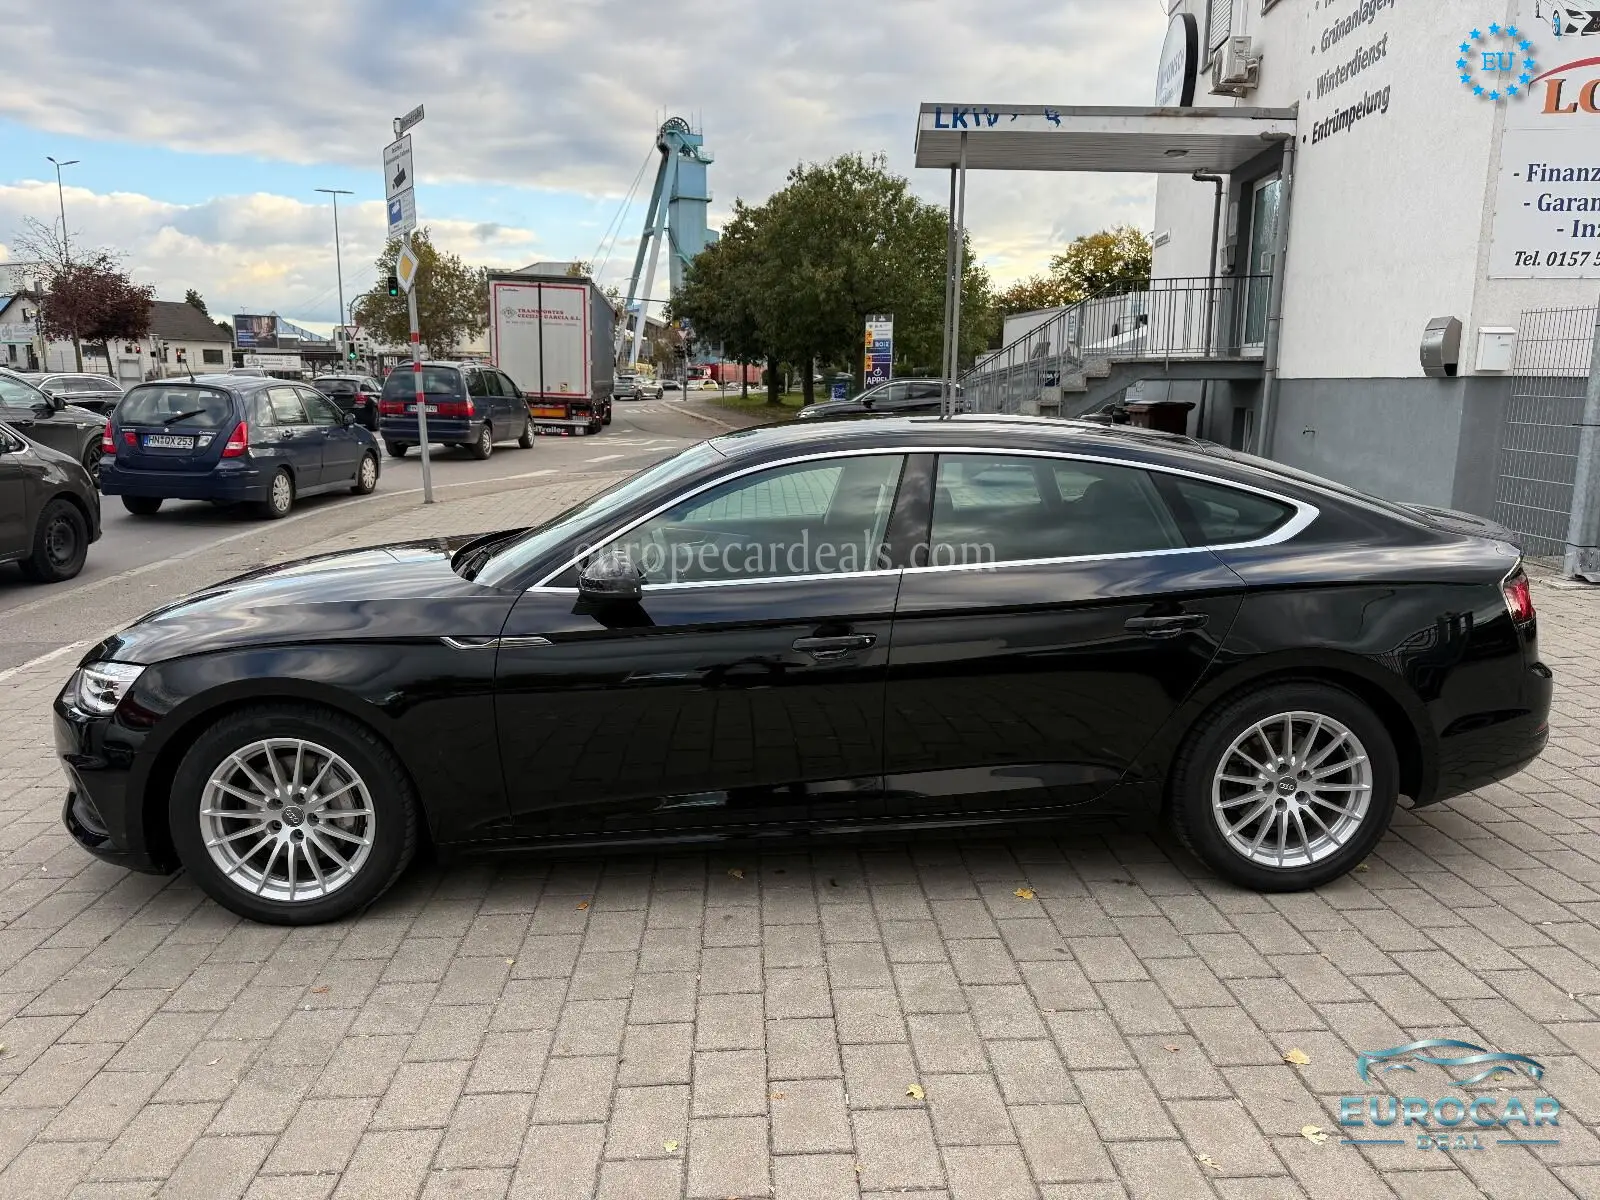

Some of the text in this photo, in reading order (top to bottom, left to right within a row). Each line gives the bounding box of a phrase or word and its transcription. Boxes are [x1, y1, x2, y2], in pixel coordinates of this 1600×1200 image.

[1317, 32, 1388, 99] Winterdienst
[1312, 84, 1390, 145] Entrümpelung
[1514, 250, 1541, 266] Tel.
[1546, 250, 1591, 267] 0157
[148, 435, 193, 446] HN QX 253
